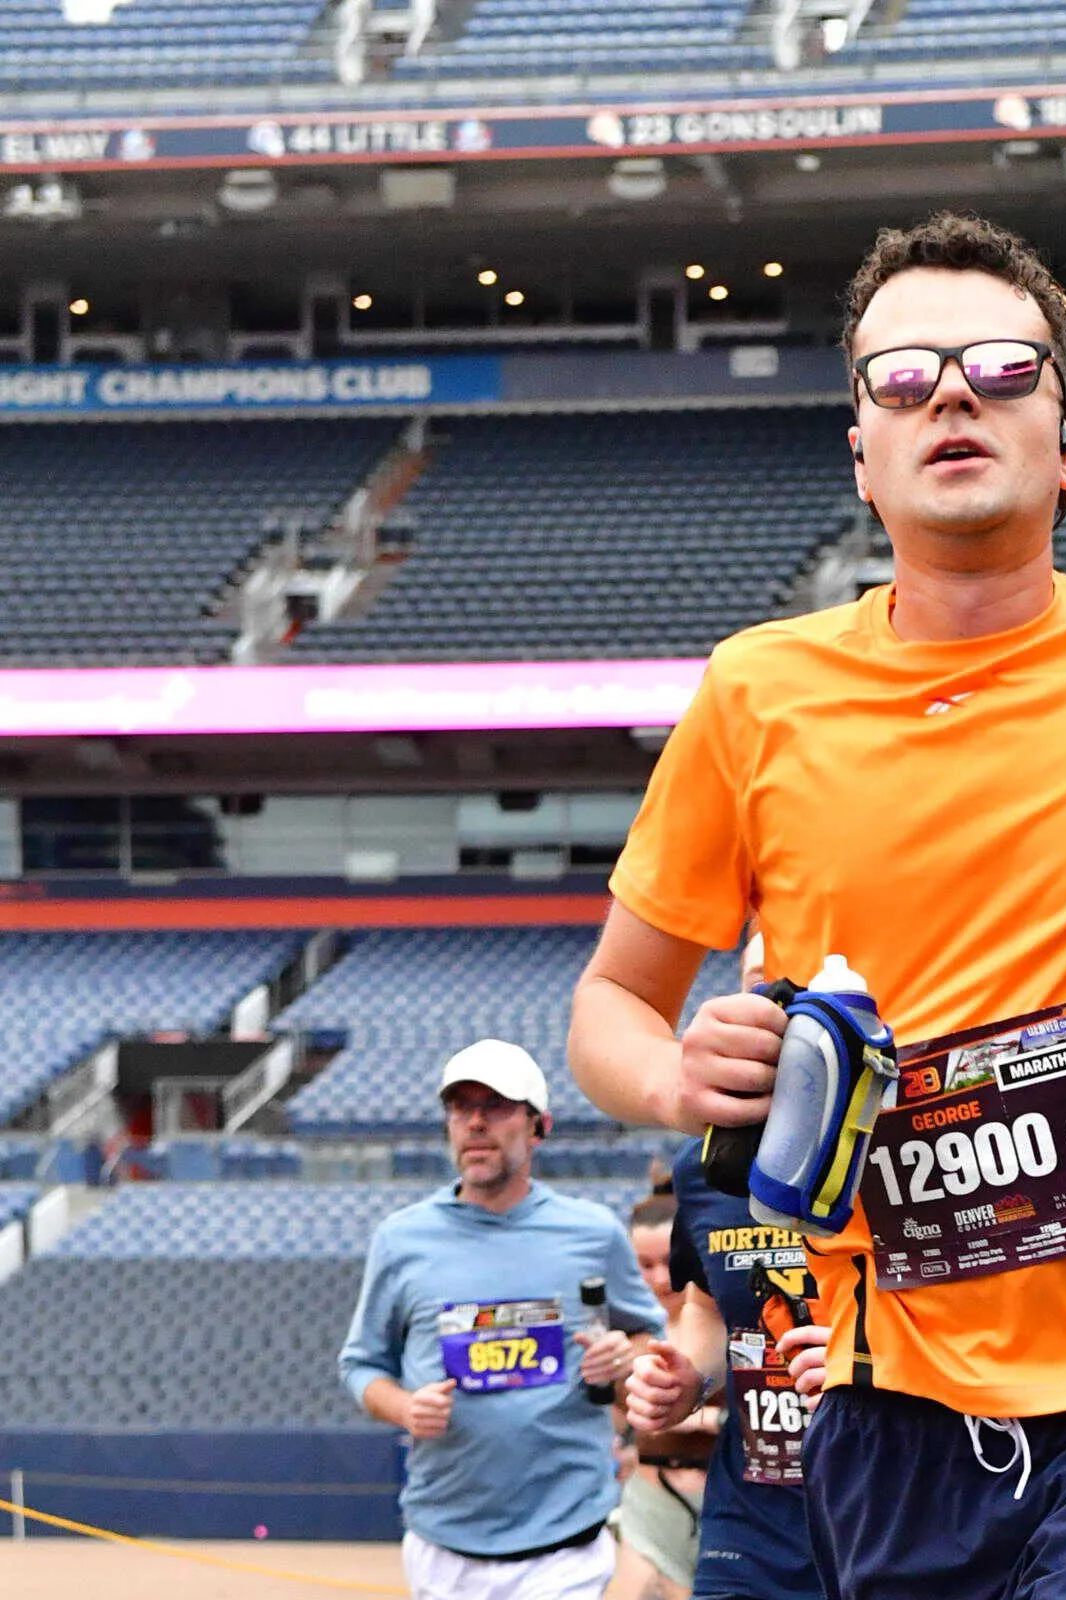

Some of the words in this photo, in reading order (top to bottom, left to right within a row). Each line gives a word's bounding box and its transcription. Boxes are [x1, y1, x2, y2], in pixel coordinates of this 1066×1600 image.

[289, 125, 331, 152] 44
[336, 121, 447, 153] LITTLE
[629, 114, 672, 145] 23
[675, 104, 882, 143] GONSOULIN
[1, 131, 110, 164] ELWAY
[99, 366, 329, 405] CHAMPIONS
[334, 364, 432, 399] CLUB
[912, 1100, 982, 1131] GEORGE
[869, 1112, 1058, 1206] 12900
[903, 1222, 942, 1240] cigna
[954, 1204, 996, 1226] DENVER
[957, 1218, 998, 1233] COLFAX
